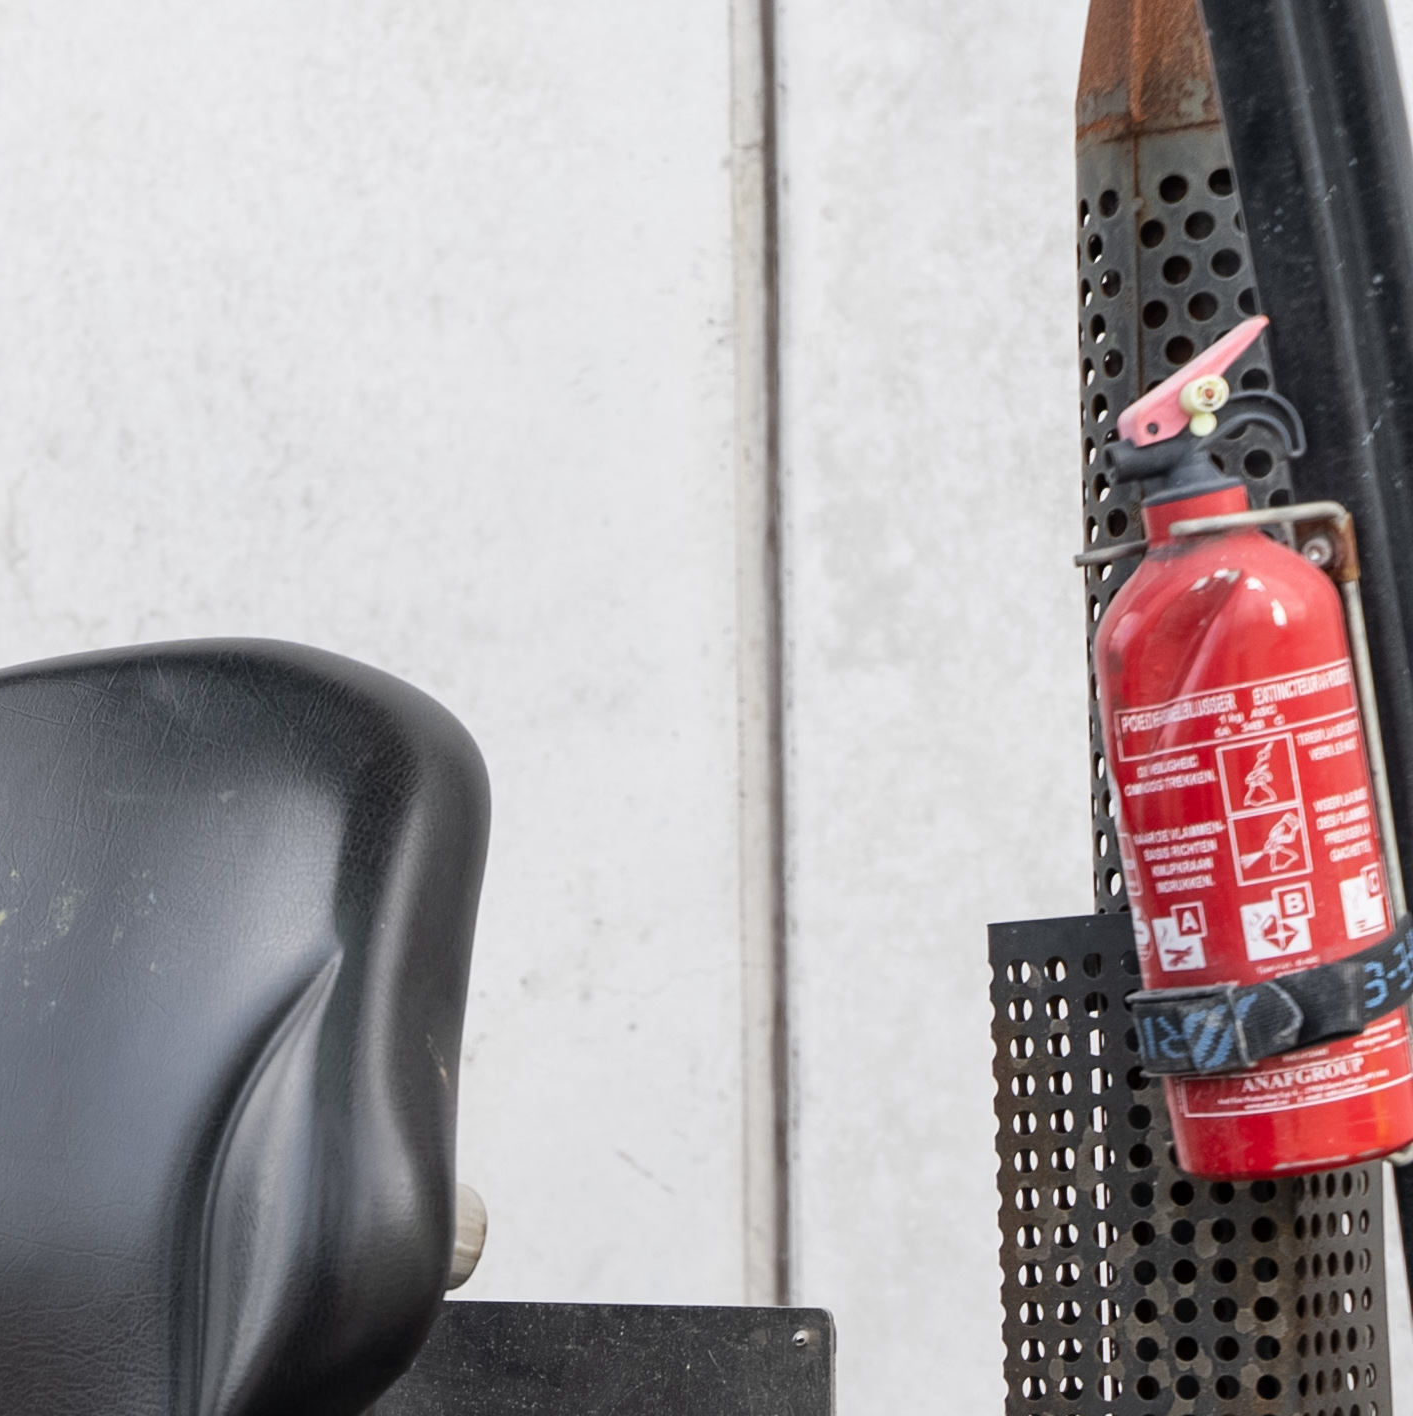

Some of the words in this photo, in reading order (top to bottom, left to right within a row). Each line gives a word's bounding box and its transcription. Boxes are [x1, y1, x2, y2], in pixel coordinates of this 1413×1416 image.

[1283, 893, 1305, 915] B
[1181, 911, 1199, 931] A
[1242, 1056, 1365, 1092] ANAFGROUP
